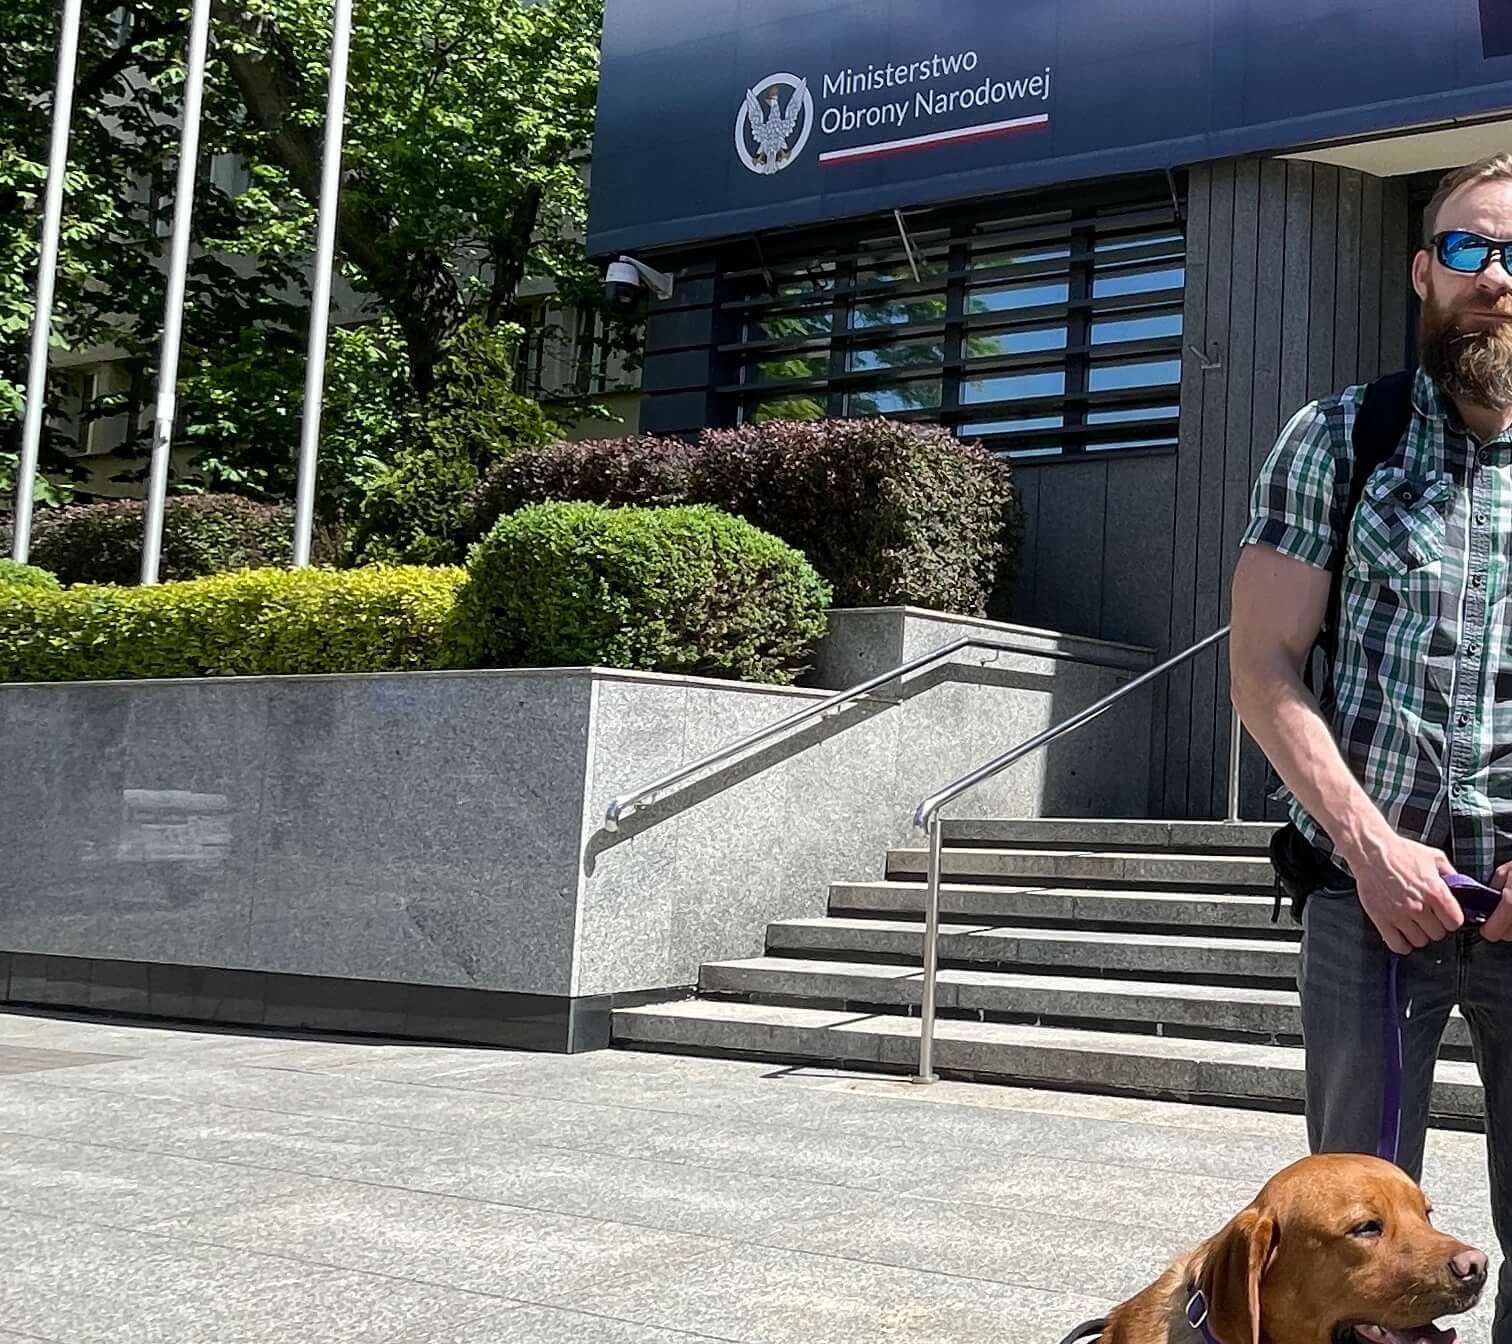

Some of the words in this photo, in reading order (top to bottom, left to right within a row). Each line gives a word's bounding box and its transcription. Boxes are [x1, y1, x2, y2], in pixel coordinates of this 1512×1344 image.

[820, 102, 909, 135] Obrony
[915, 67, 1052, 119] Narodowej
[821, 50, 978, 99] Ministerstwo
